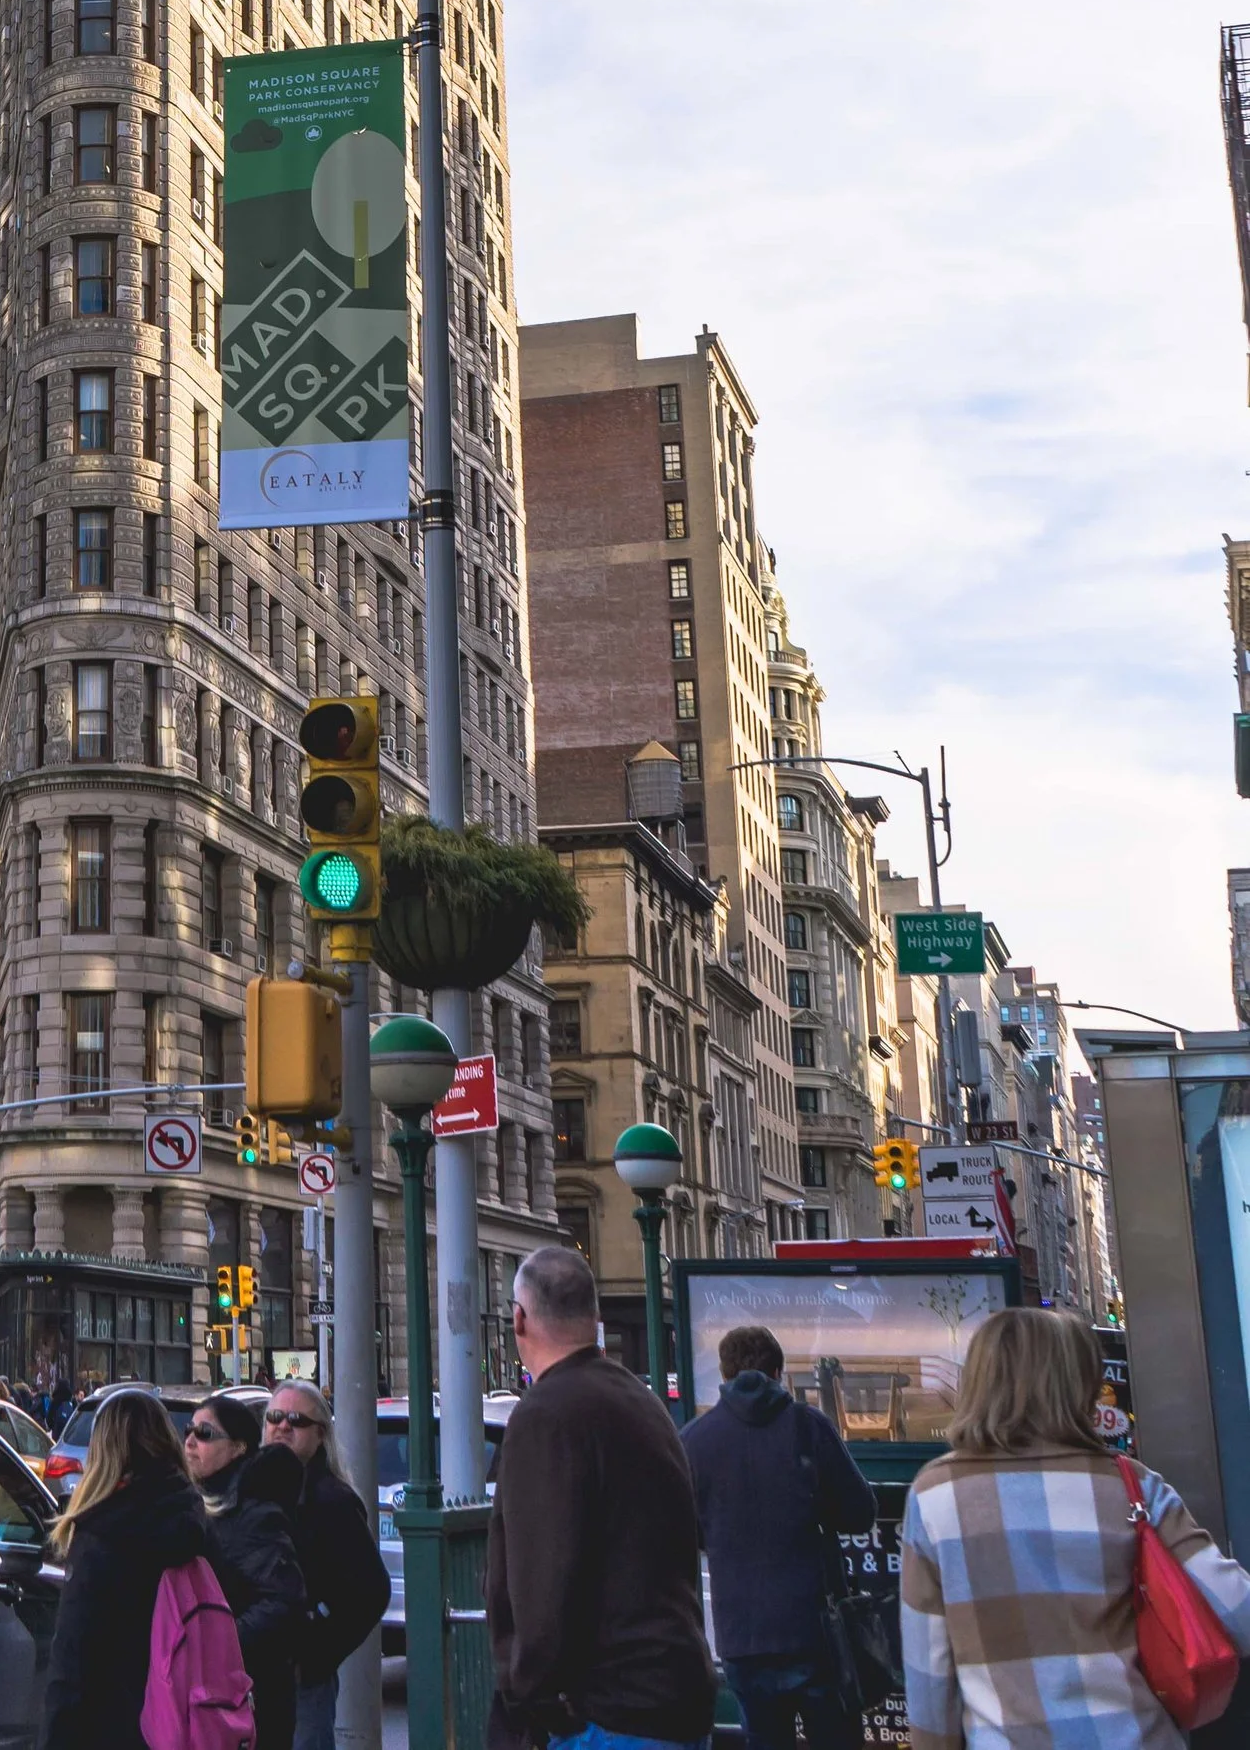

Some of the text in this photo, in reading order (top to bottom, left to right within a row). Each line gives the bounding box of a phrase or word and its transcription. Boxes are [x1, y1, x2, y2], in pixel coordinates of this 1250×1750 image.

[249, 66, 380, 90] MADISON SQUARE
[249, 80, 379, 102] PARK CONSERVANCY
[258, 96, 370, 113] madisonsquarepark.org
[273, 109, 354, 124] @MadSqParkNYC
[221, 287, 327, 391] MAD.
[258, 363, 340, 430] SQ.
[335, 363, 407, 434] PK
[271, 470, 365, 489] EATALY
[902, 918, 977, 932] West Side
[908, 935, 973, 950] Highway
[971, 1126, 1014, 1139] W 23 St
[961, 1157, 992, 1167] TRUCK
[962, 1175, 994, 1186] ROUTE
[929, 1214, 960, 1224] LOCAL
[704, 1290, 728, 1306] We
[731, 1290, 762, 1309] help
[764, 1294, 791, 1310] you
[795, 1290, 830, 1306] make
[862, 1552, 878, 1572] &
[874, 1715, 889, 1726] or
[864, 1728, 875, 1741] &
